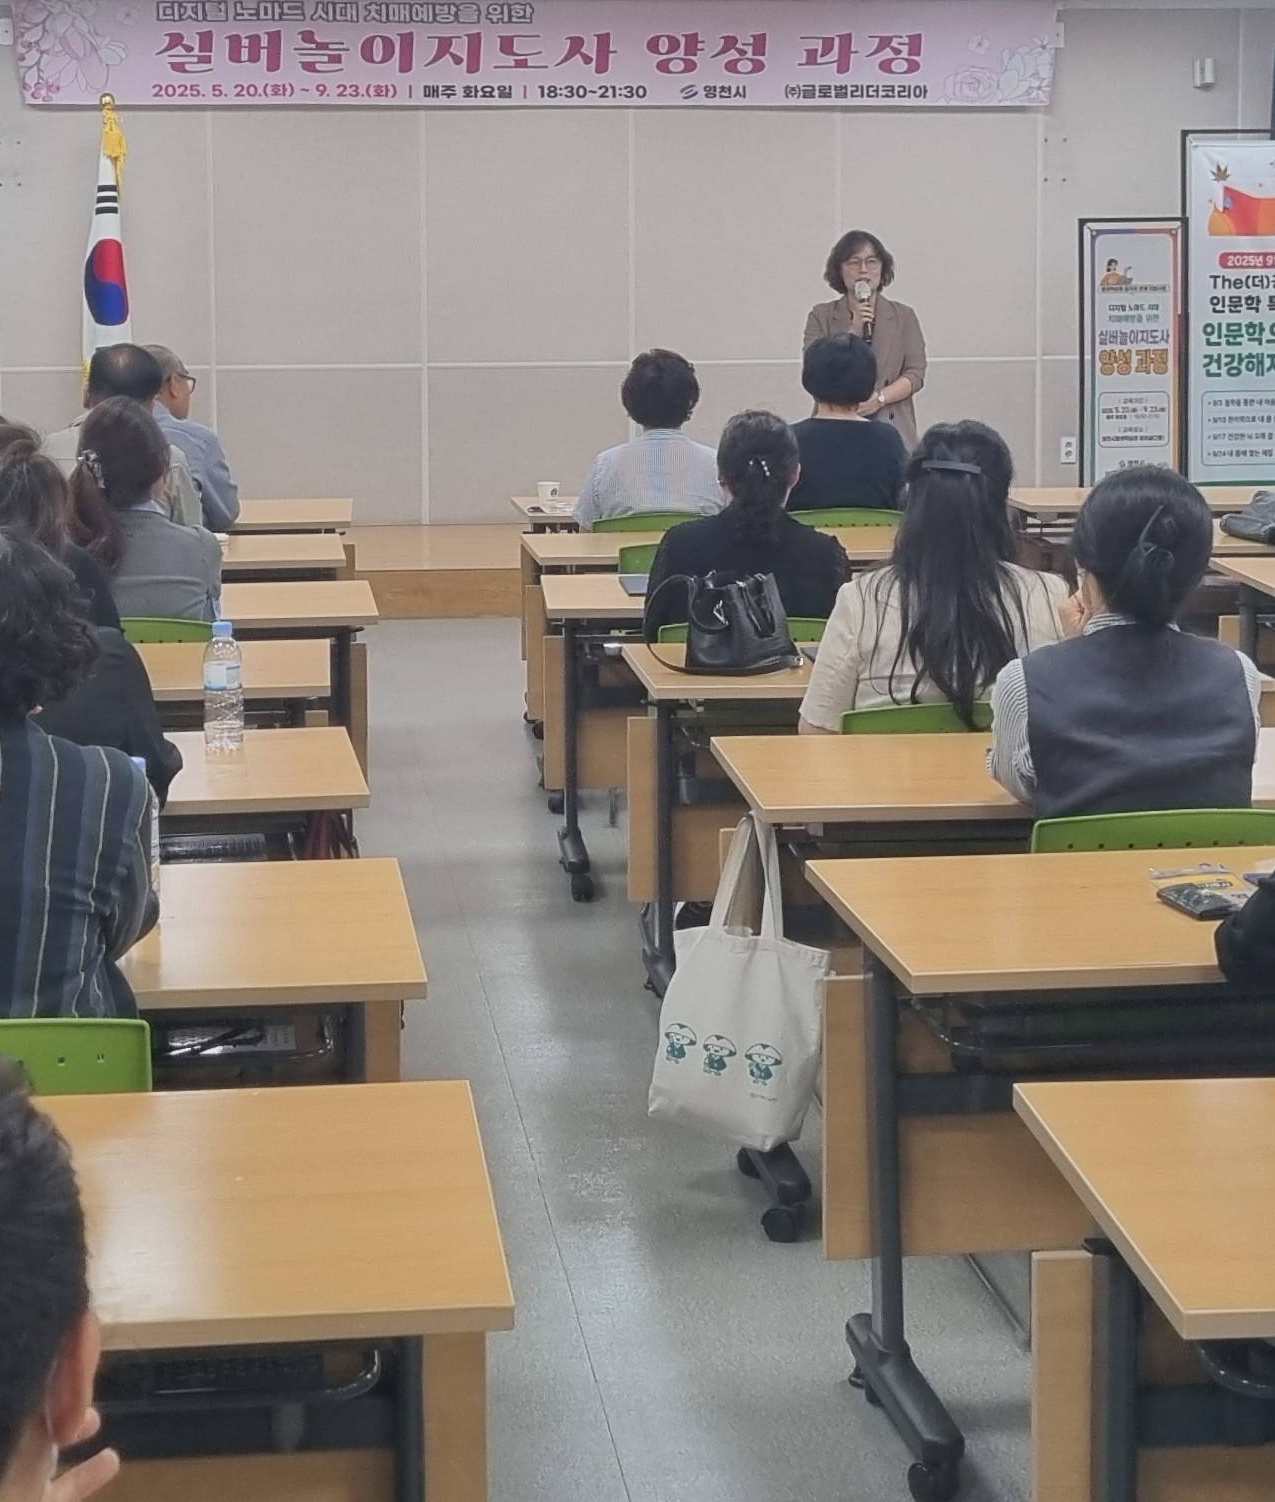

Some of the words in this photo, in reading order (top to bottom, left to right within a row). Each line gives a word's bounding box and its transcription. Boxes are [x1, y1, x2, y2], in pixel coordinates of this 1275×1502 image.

[156, 1, 229, 22] 디지털
[233, 1, 306, 22] 노마드
[310, 1, 359, 23] 시대
[364, 2, 481, 24] 치매예방을
[485, 2, 535, 24] 위한
[154, 29, 618, 75] 실버놀이지도사
[645, 32, 768, 75] 양성
[797, 32, 924, 75] 과정
[152, 83, 206, 97] 2025.
[211, 83, 228, 97] 5.
[233, 83, 295, 98] 20.(화)
[315, 84, 330, 98] 9.
[336, 84, 398, 98] 23.(화)
[423, 84, 457, 99] 매주
[462, 84, 513, 99] 화요일
[537, 84, 647, 99] 18:30~21:30
[703, 84, 747, 99] 영천시
[1227, 255, 1264, 266] 2025년
[1209, 295, 1262, 313] 인문학
[1098, 328, 1170, 346] 실버놀이지도사
[1098, 348, 1132, 376] 양성
[1135, 348, 1169, 375] 과정
